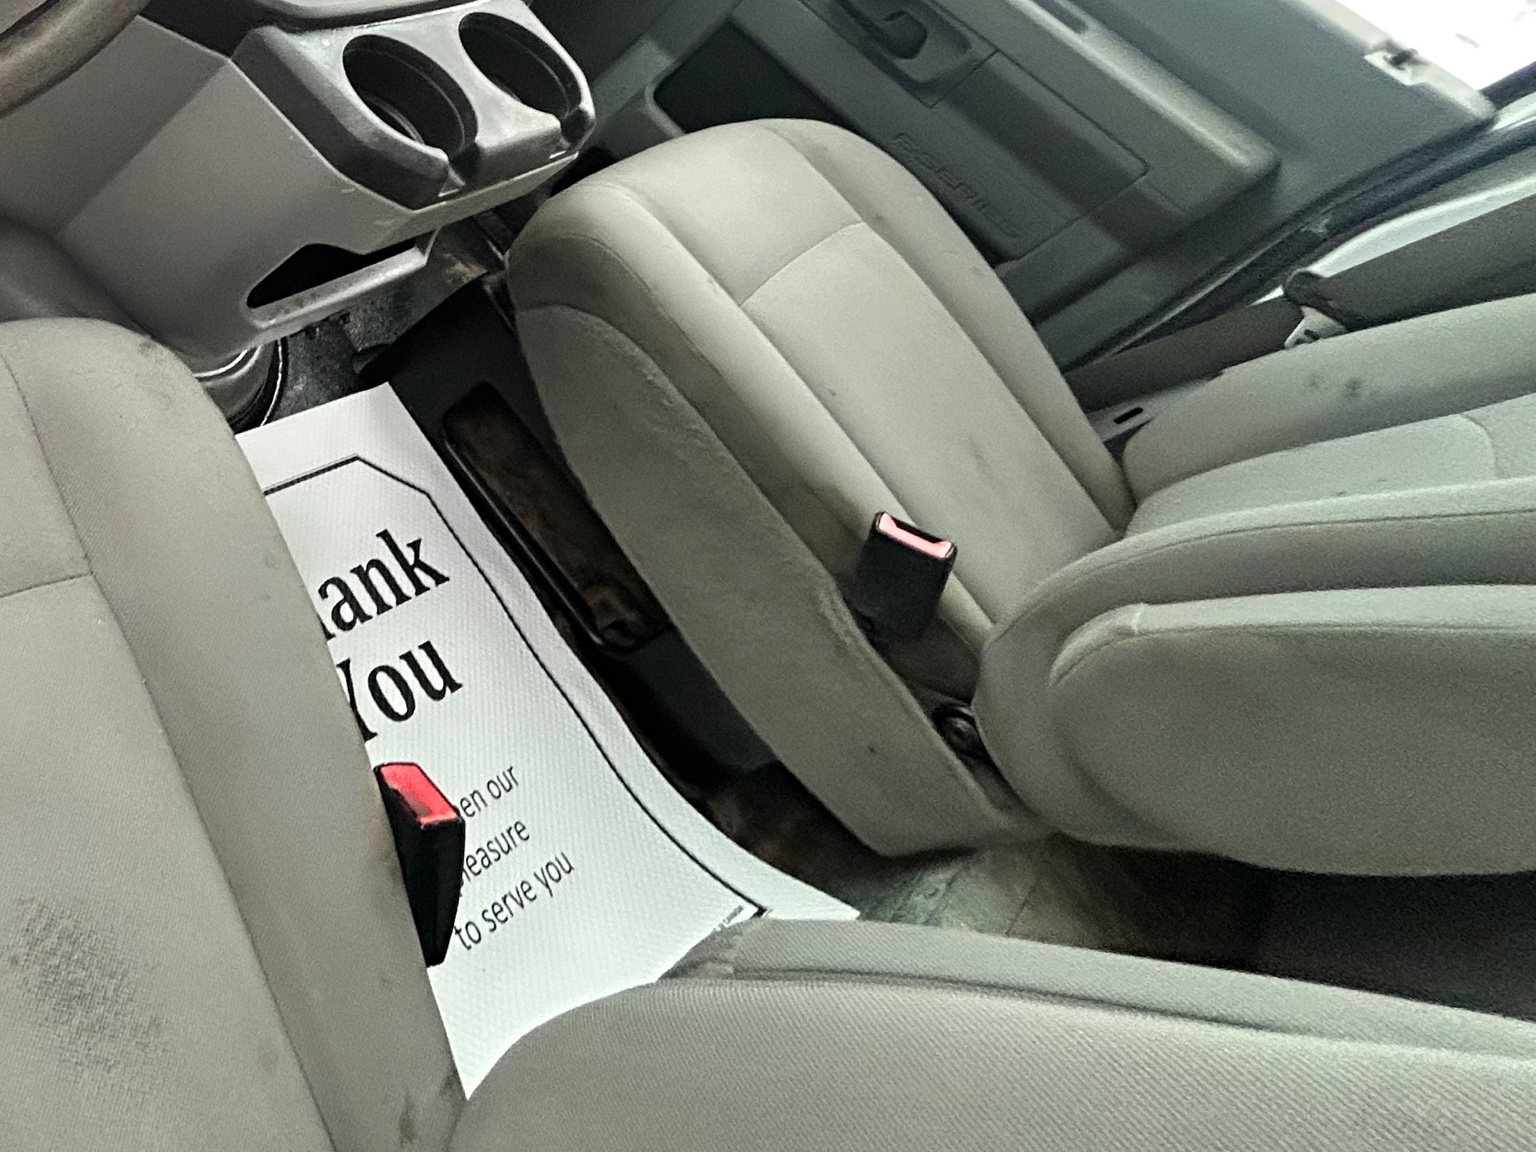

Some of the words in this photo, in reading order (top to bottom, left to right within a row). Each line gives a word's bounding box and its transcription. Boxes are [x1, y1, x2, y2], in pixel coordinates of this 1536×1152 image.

[318, 528, 450, 641] ank
[459, 789, 488, 818] en
[486, 765, 519, 800] our
[462, 820, 530, 884] easure
[453, 920, 482, 951] to
[481, 880, 537, 933] serve
[533, 851, 575, 898] you
